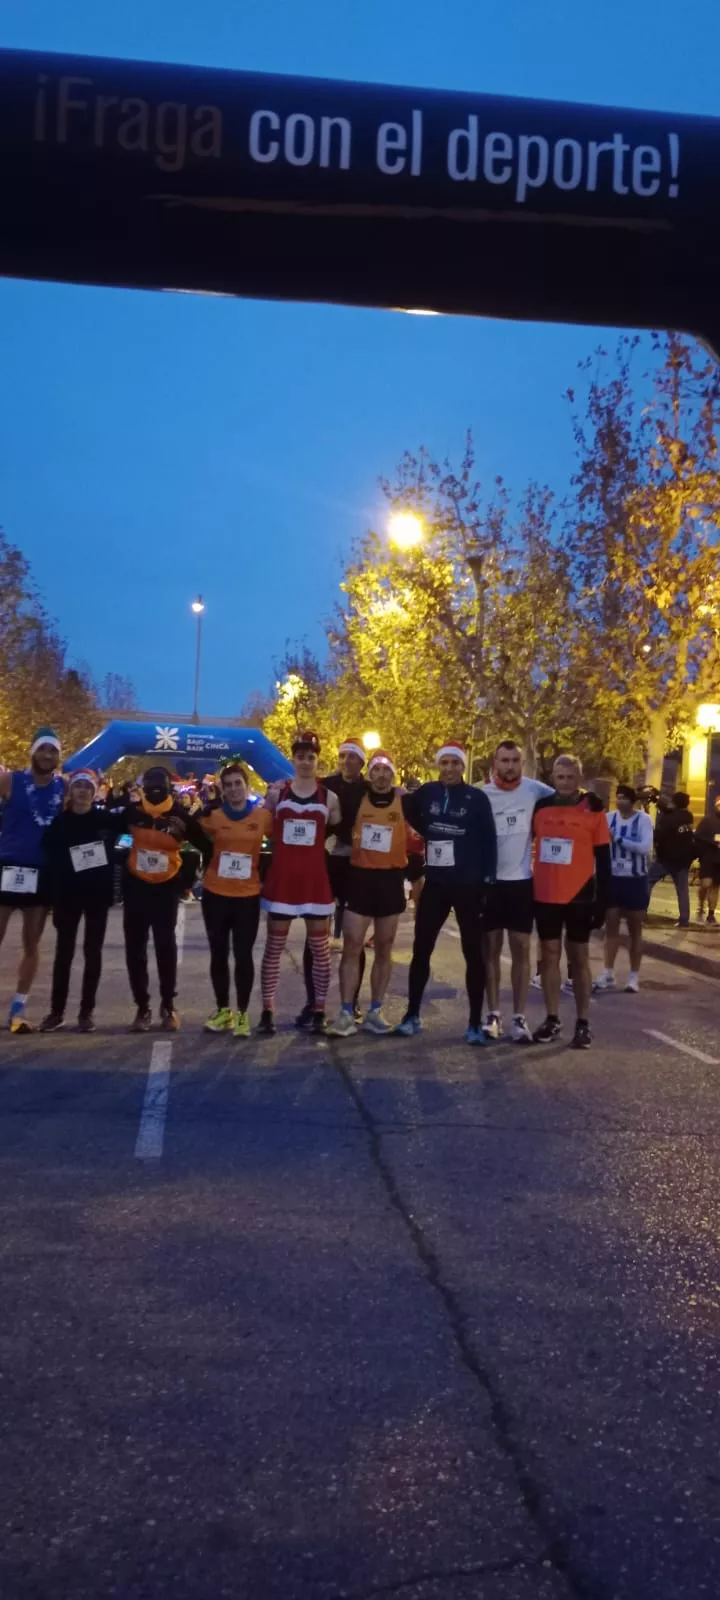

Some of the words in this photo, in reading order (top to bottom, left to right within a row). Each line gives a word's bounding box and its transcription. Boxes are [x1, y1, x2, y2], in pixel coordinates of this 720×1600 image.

[34, 74, 223, 171] ¡Fraga
[248, 109, 351, 170] con
[375, 110, 423, 177] el
[447, 114, 681, 202] deporte!
[205, 742, 229, 750] CINCA
